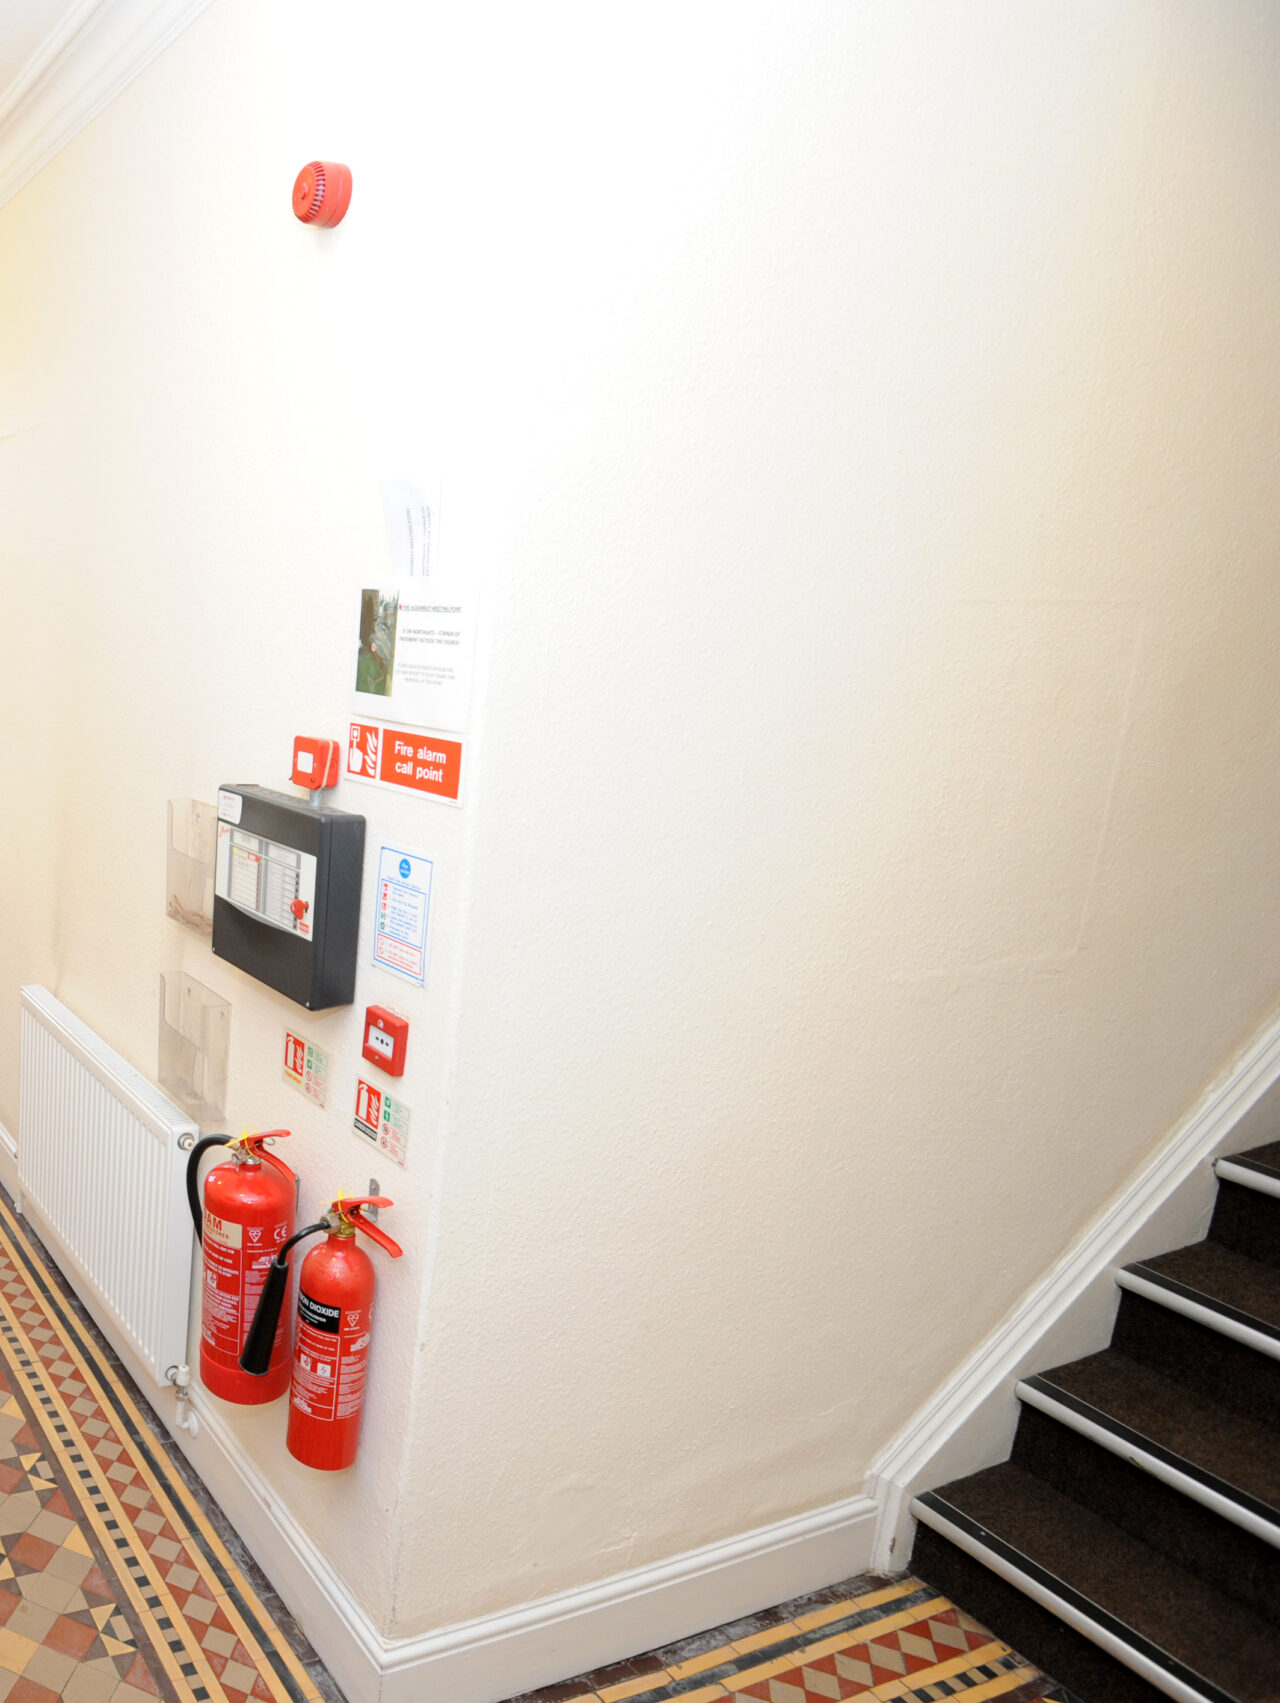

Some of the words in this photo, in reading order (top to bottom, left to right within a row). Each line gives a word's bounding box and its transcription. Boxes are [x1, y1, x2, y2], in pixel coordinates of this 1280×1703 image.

[394, 740, 414, 757] Fire
[417, 746, 446, 764] alarm
[395, 761, 413, 775] call
[416, 766, 443, 783] point
[309, 1301, 340, 1318] DIOXIDE
